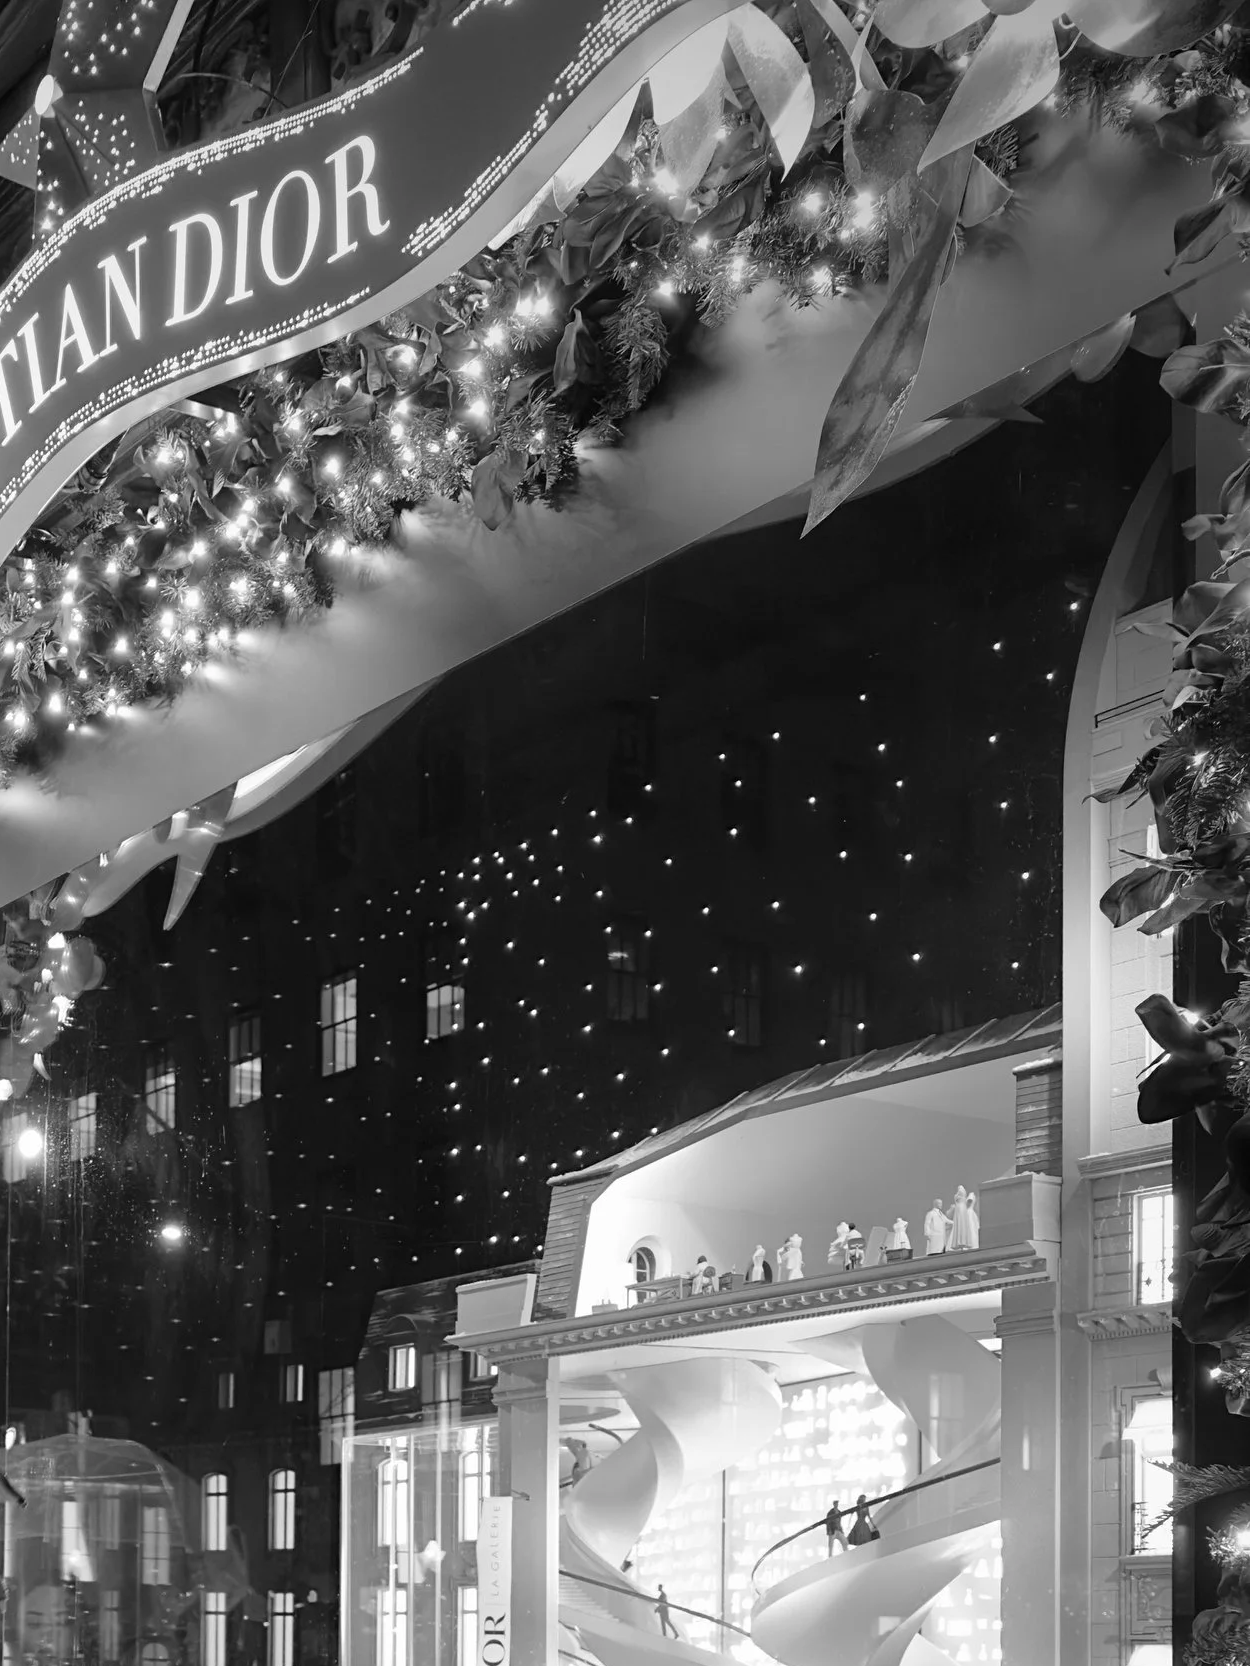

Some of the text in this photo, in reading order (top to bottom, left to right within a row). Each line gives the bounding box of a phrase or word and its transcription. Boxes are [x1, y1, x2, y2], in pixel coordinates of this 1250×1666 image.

[164, 134, 391, 327] DIOR
[491, 1505, 501, 1573] GALERIE
[492, 1577, 500, 1596] LA
